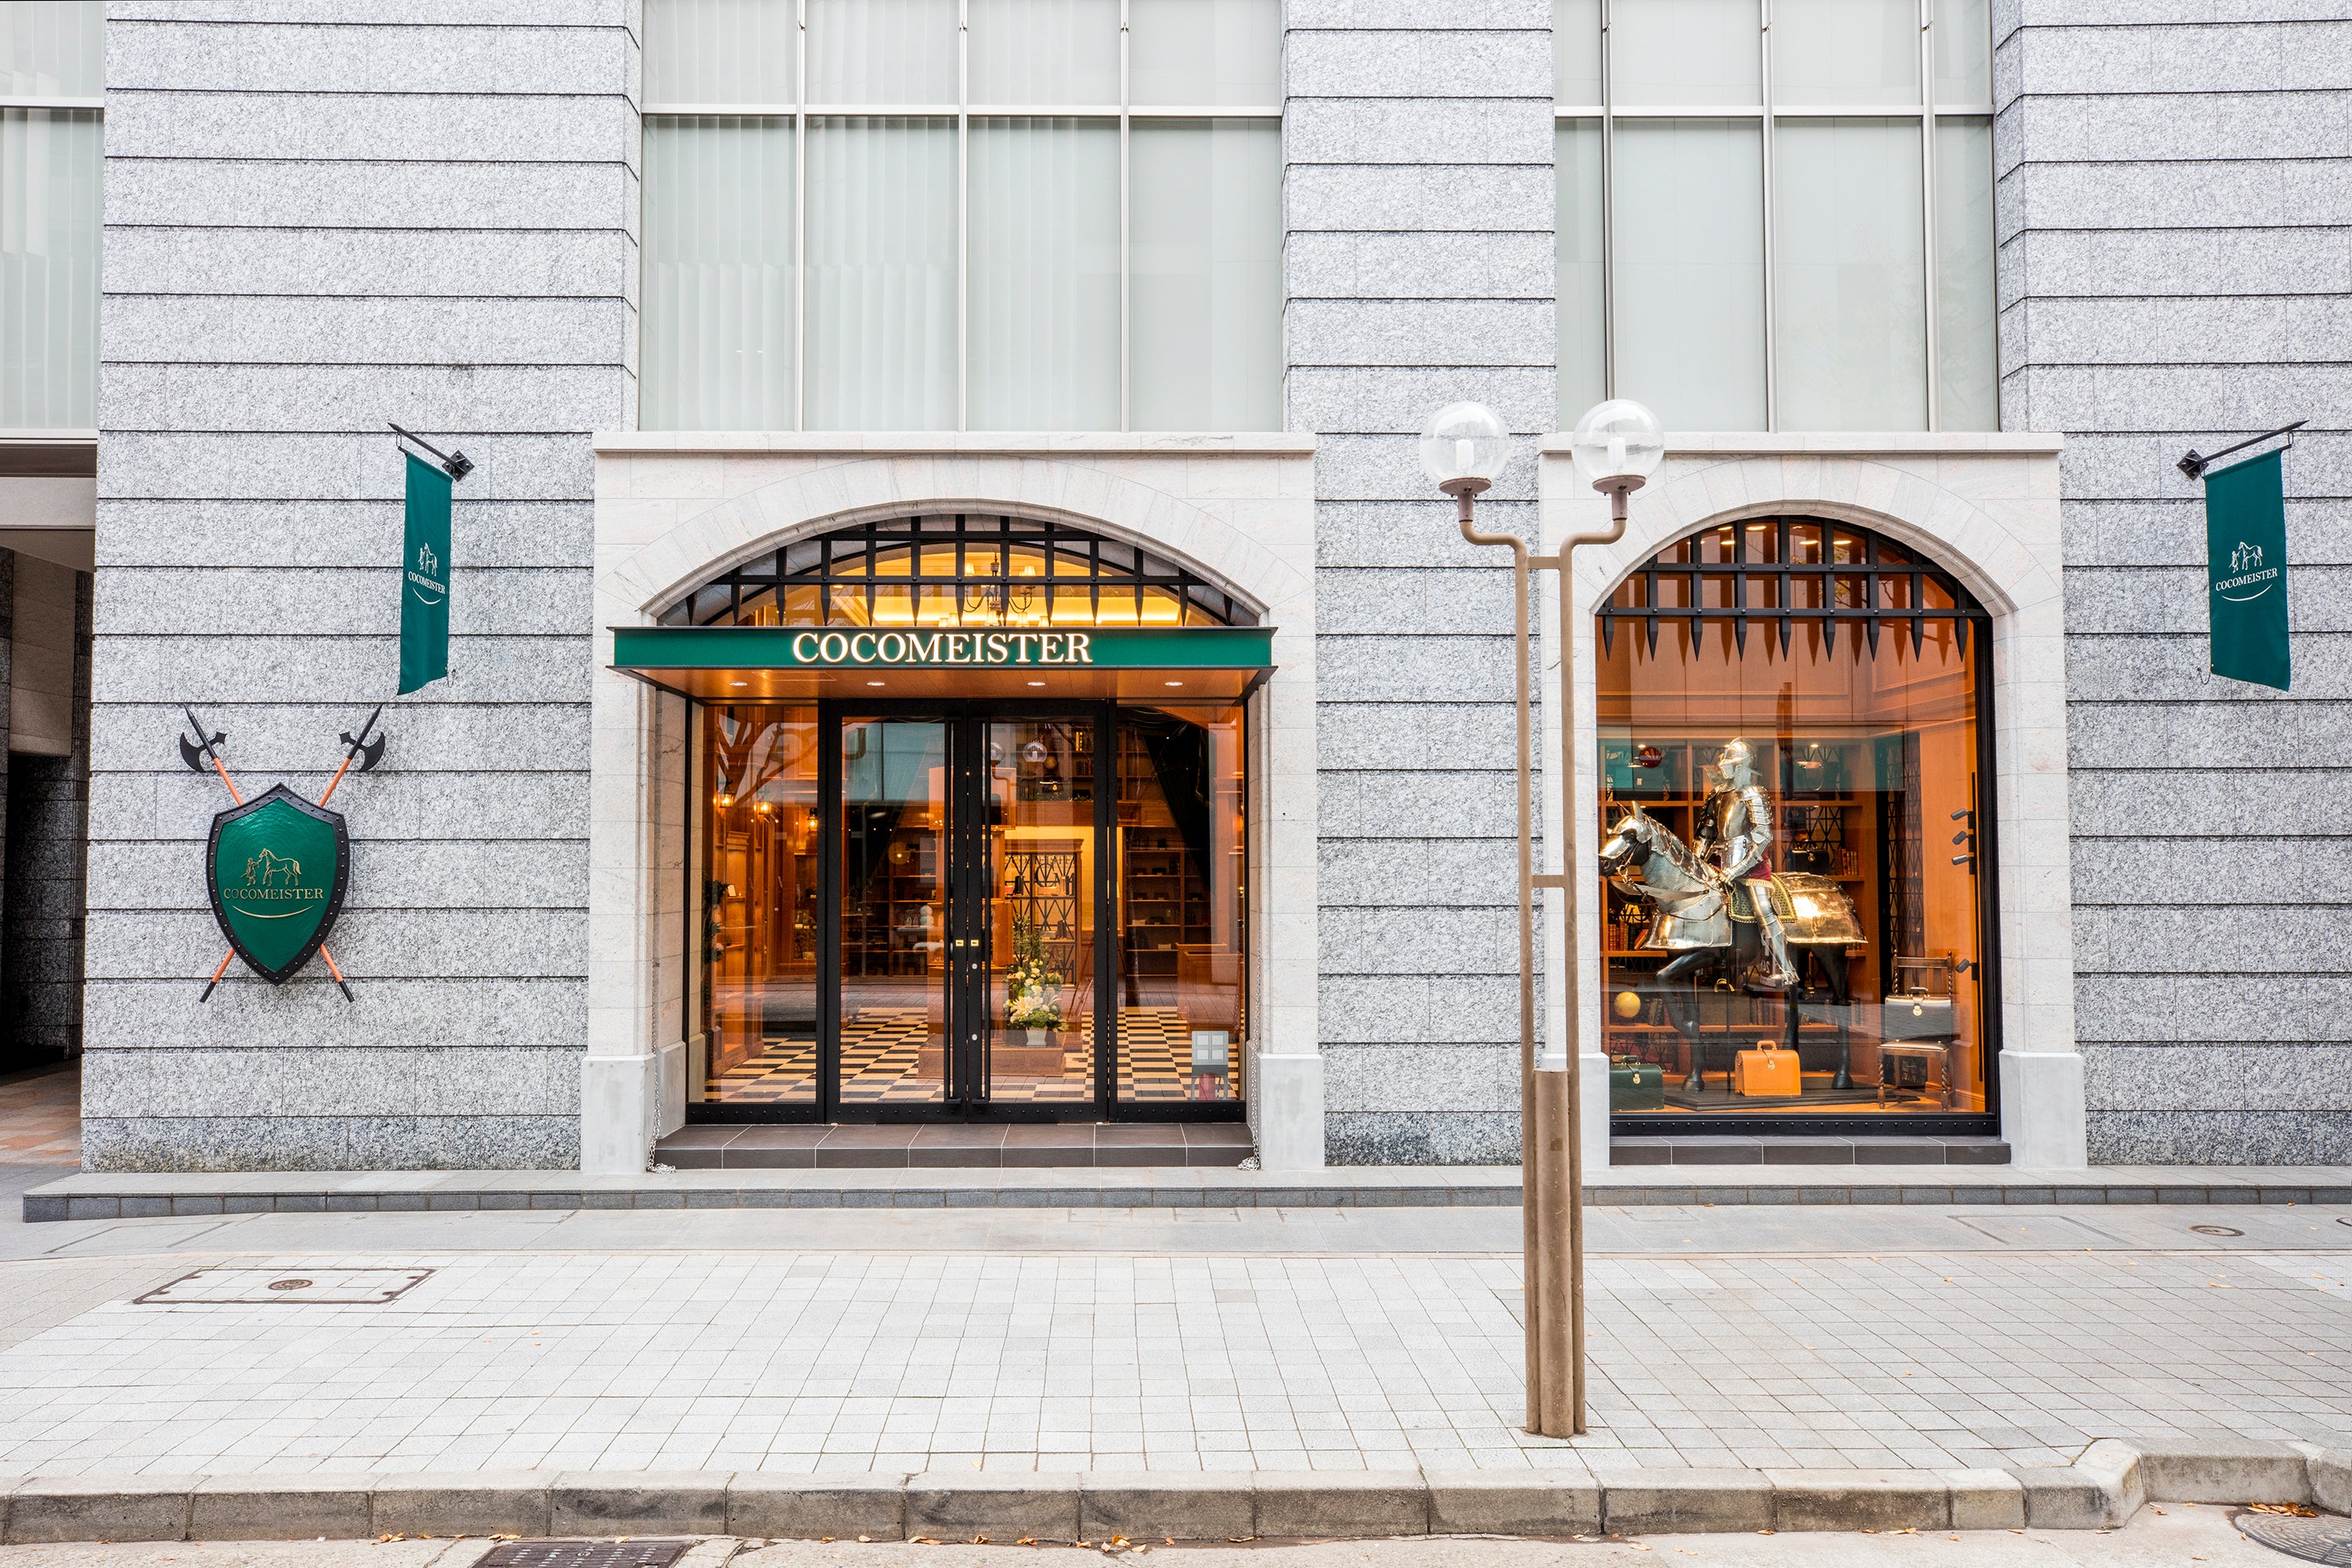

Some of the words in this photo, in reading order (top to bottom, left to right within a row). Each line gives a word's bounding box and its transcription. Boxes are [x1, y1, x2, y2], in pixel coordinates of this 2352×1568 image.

[408, 571, 445, 594] COCOMEISTER
[2216, 568, 2278, 591] COCOMEISTER
[793, 633, 1093, 663] COCOMEISTER
[223, 887, 324, 900] COCOMEISTER
